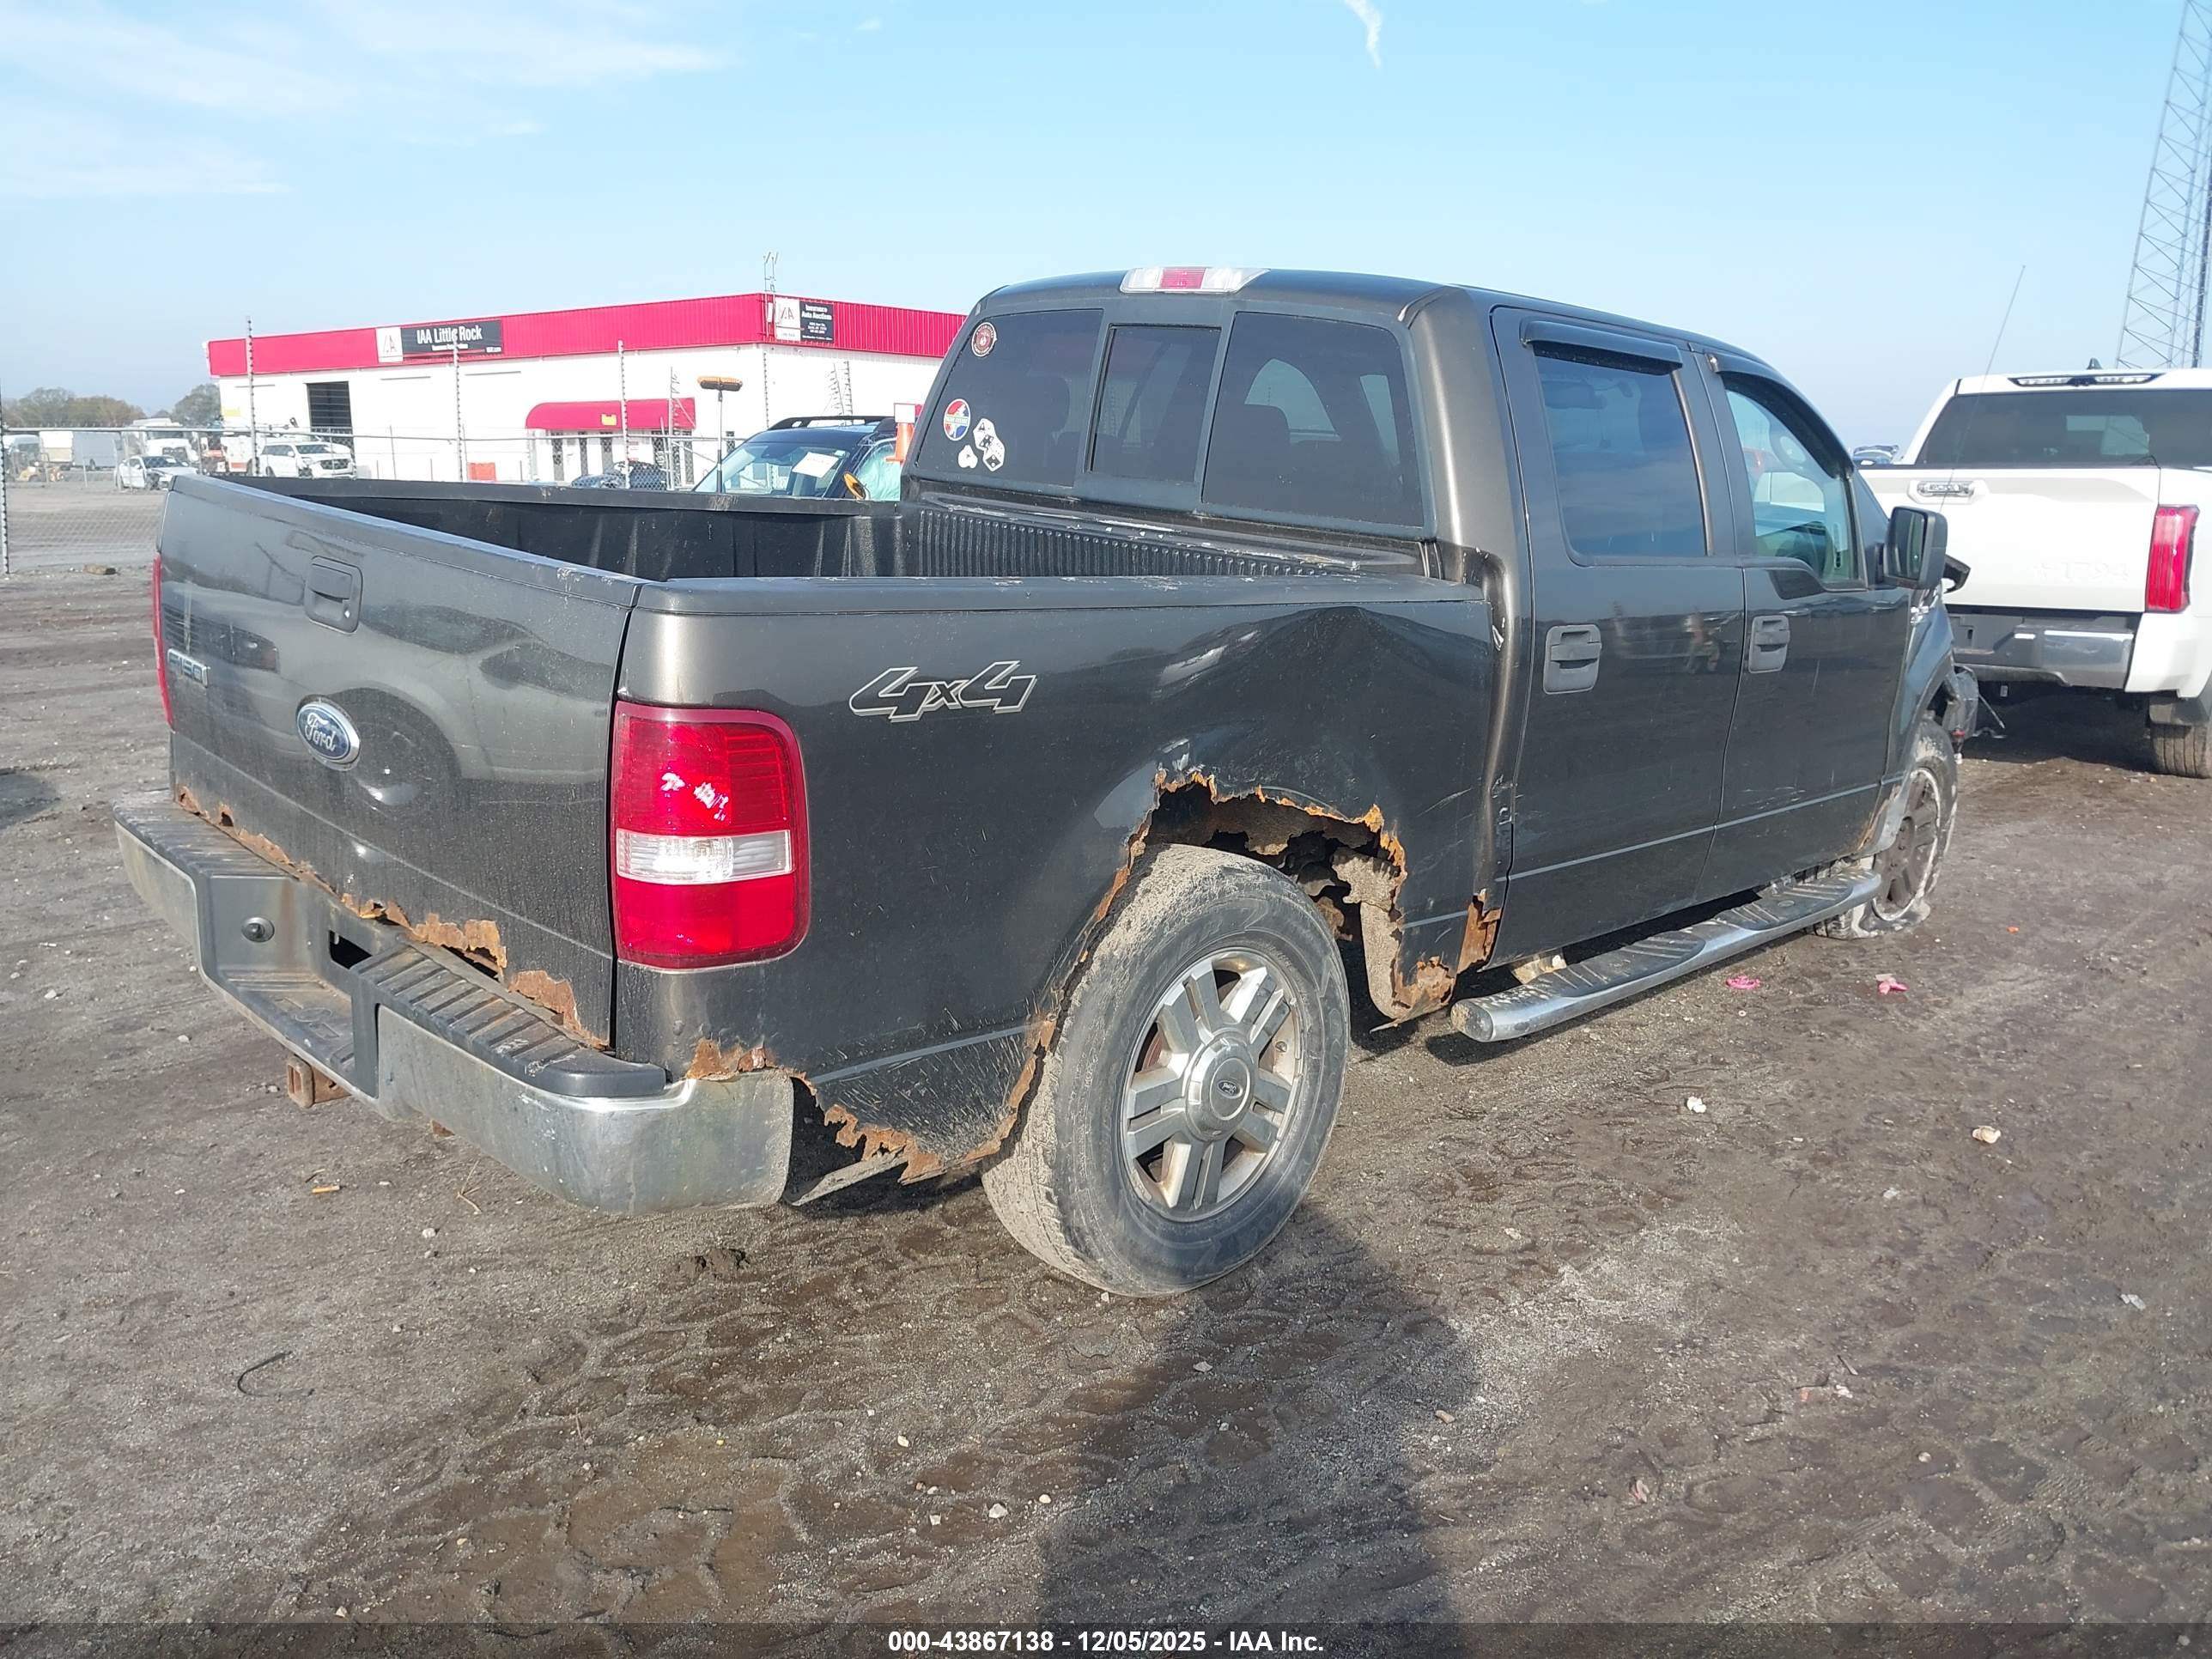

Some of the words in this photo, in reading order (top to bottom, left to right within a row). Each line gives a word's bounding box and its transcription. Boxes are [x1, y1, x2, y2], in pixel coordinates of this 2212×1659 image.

[416, 329, 433, 344] IAA
[434, 327, 458, 343] Little
[459, 325, 483, 342] Rock
[848, 659, 1038, 724] 4x4
[305, 711, 337, 753] Ford
